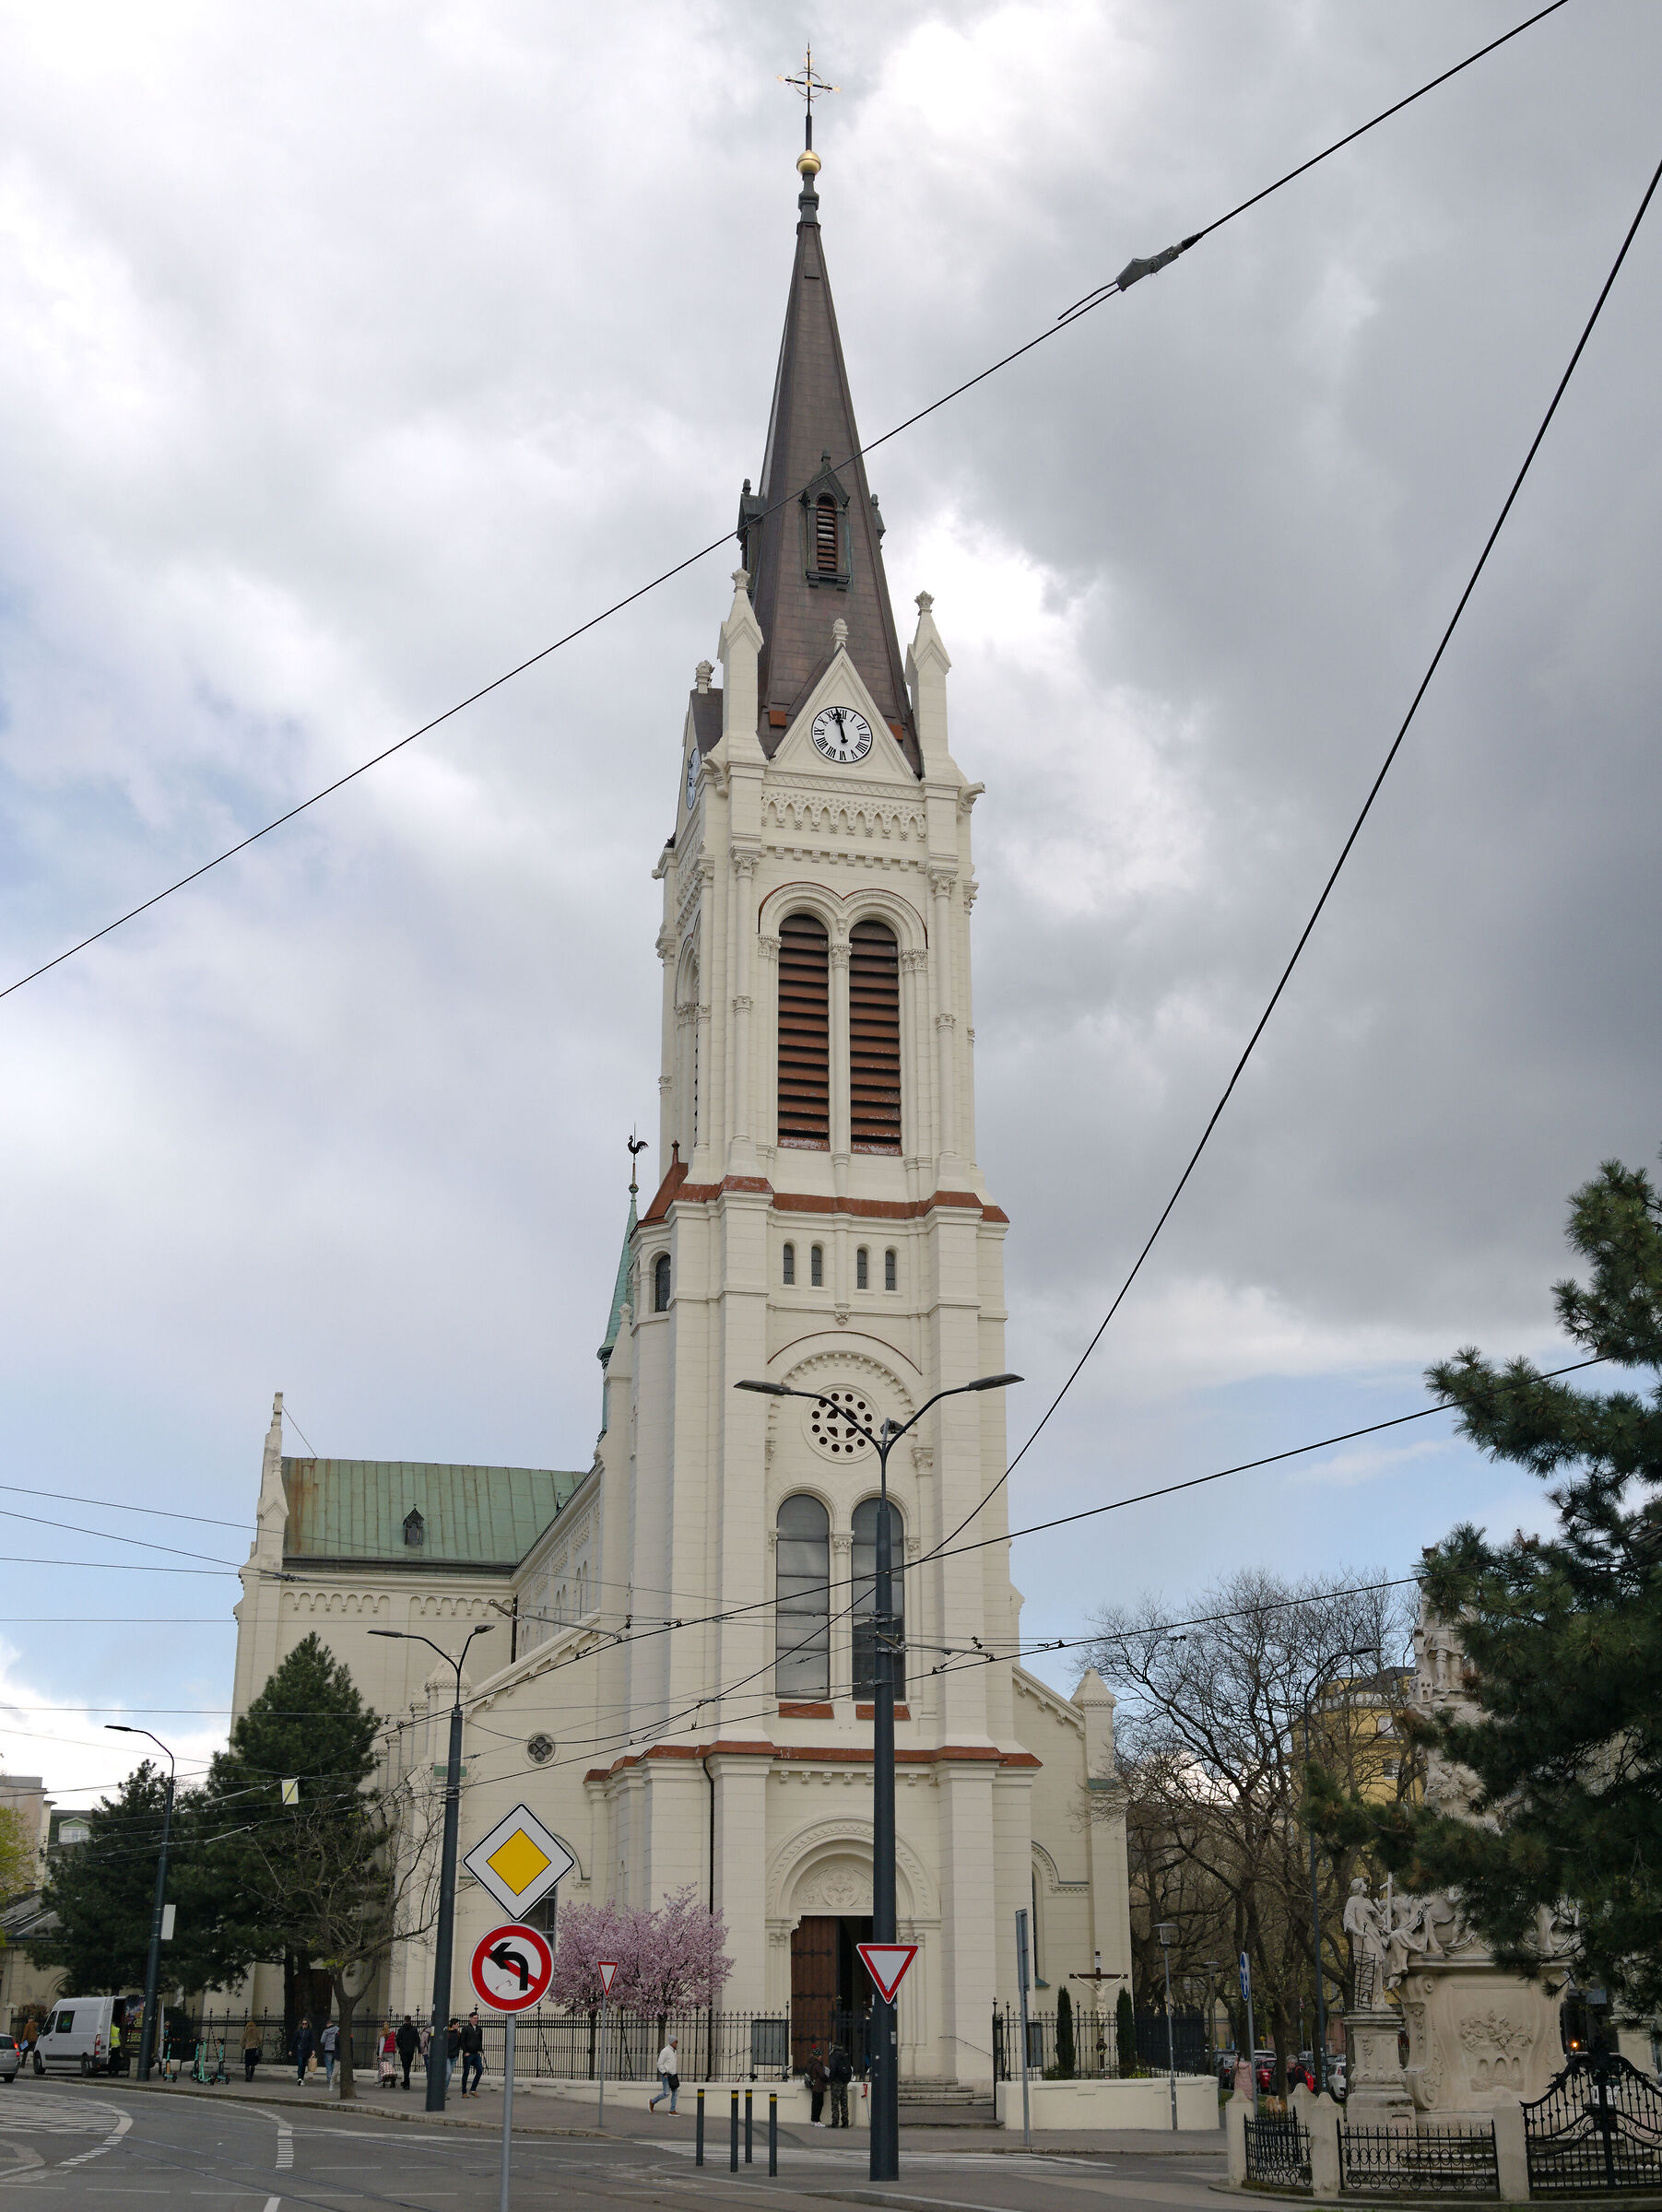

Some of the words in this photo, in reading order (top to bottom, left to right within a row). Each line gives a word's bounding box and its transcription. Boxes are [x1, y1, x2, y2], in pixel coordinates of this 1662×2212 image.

[818, 716, 829, 726] X
[850, 714, 856, 723] I
[814, 726, 825, 735] IX
[856, 723, 866, 731] II
[859, 733, 869, 742] III
[816, 736, 829, 750] VIII
[855, 741, 868, 753] IIII
[826, 746, 836, 758] VII
[839, 750, 846, 760] VI
[850, 749, 858, 759] V
